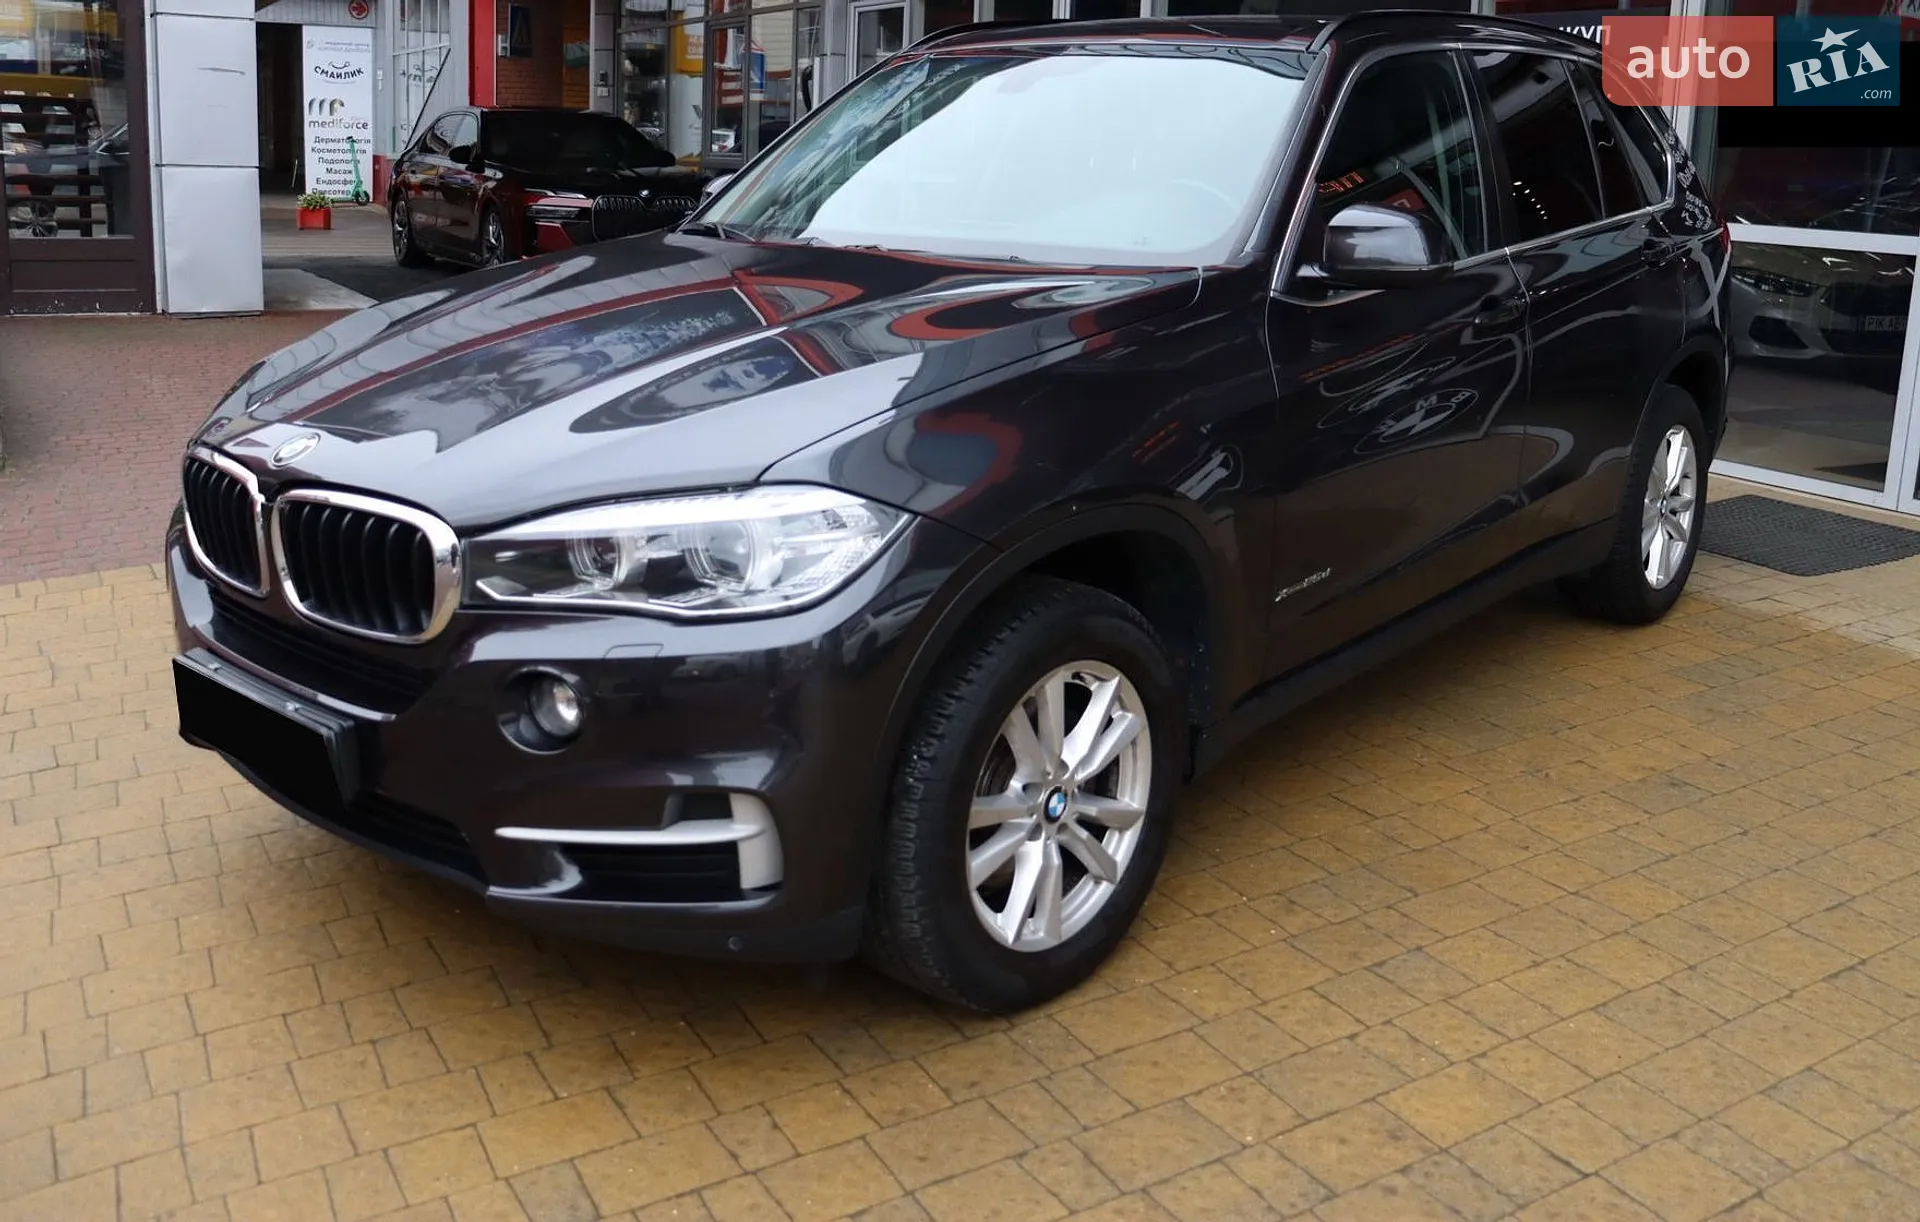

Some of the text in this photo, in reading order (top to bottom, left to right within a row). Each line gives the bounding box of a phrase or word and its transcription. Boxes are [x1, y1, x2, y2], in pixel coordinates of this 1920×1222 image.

[308, 118, 369, 130] mediforce
[314, 136, 371, 144] Дерматоогія
[311, 146, 367, 154] Косметолгія
[326, 167, 352, 175] Масаж
[316, 177, 363, 186] Ендосфеа
